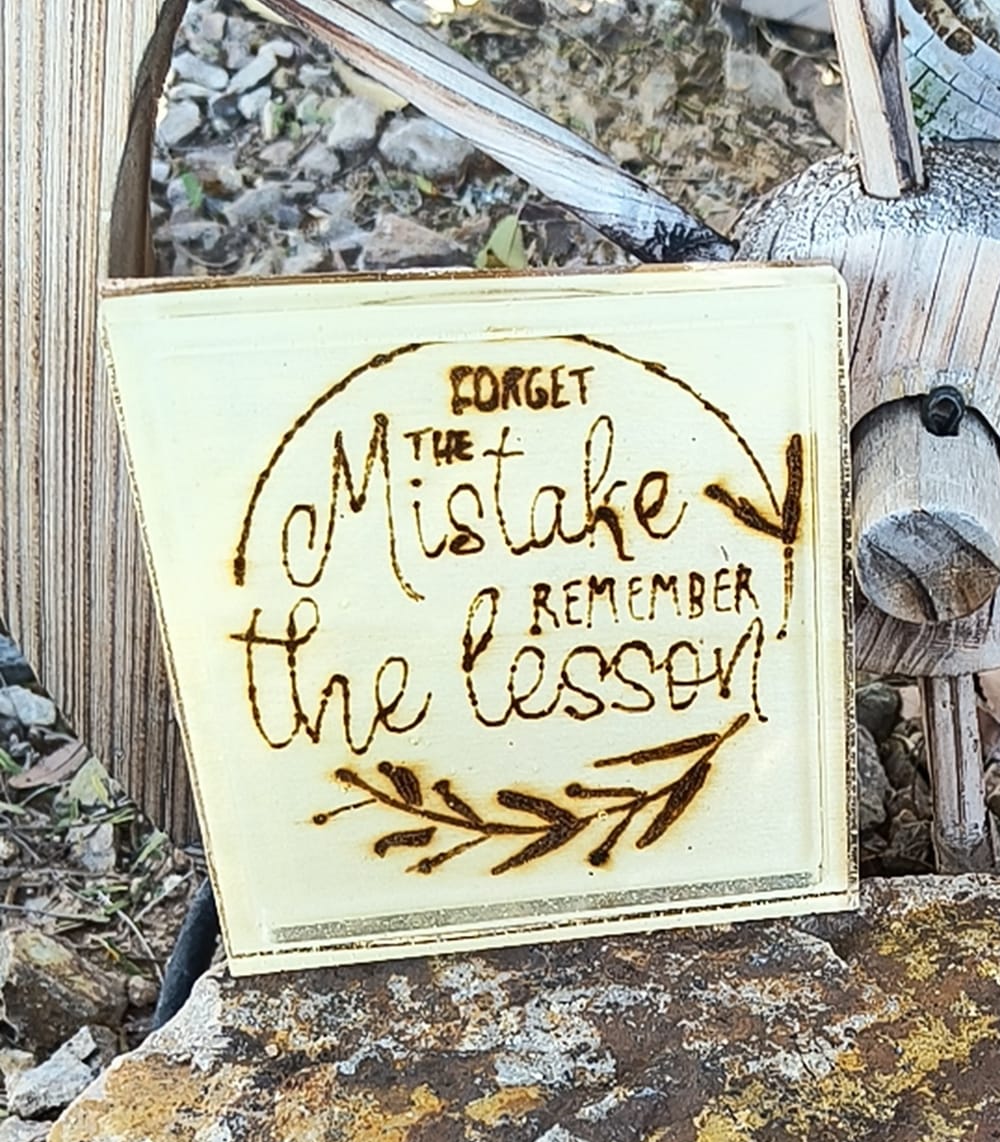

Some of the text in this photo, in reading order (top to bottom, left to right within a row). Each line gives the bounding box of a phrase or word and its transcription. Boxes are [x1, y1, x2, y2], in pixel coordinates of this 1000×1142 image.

[450, 365, 594, 413] FORGET
[404, 430, 473, 464] THE
[281, 413, 688, 603] Mistake
[530, 566, 760, 635] REMEMBER
[230, 588, 768, 755] the lesson
